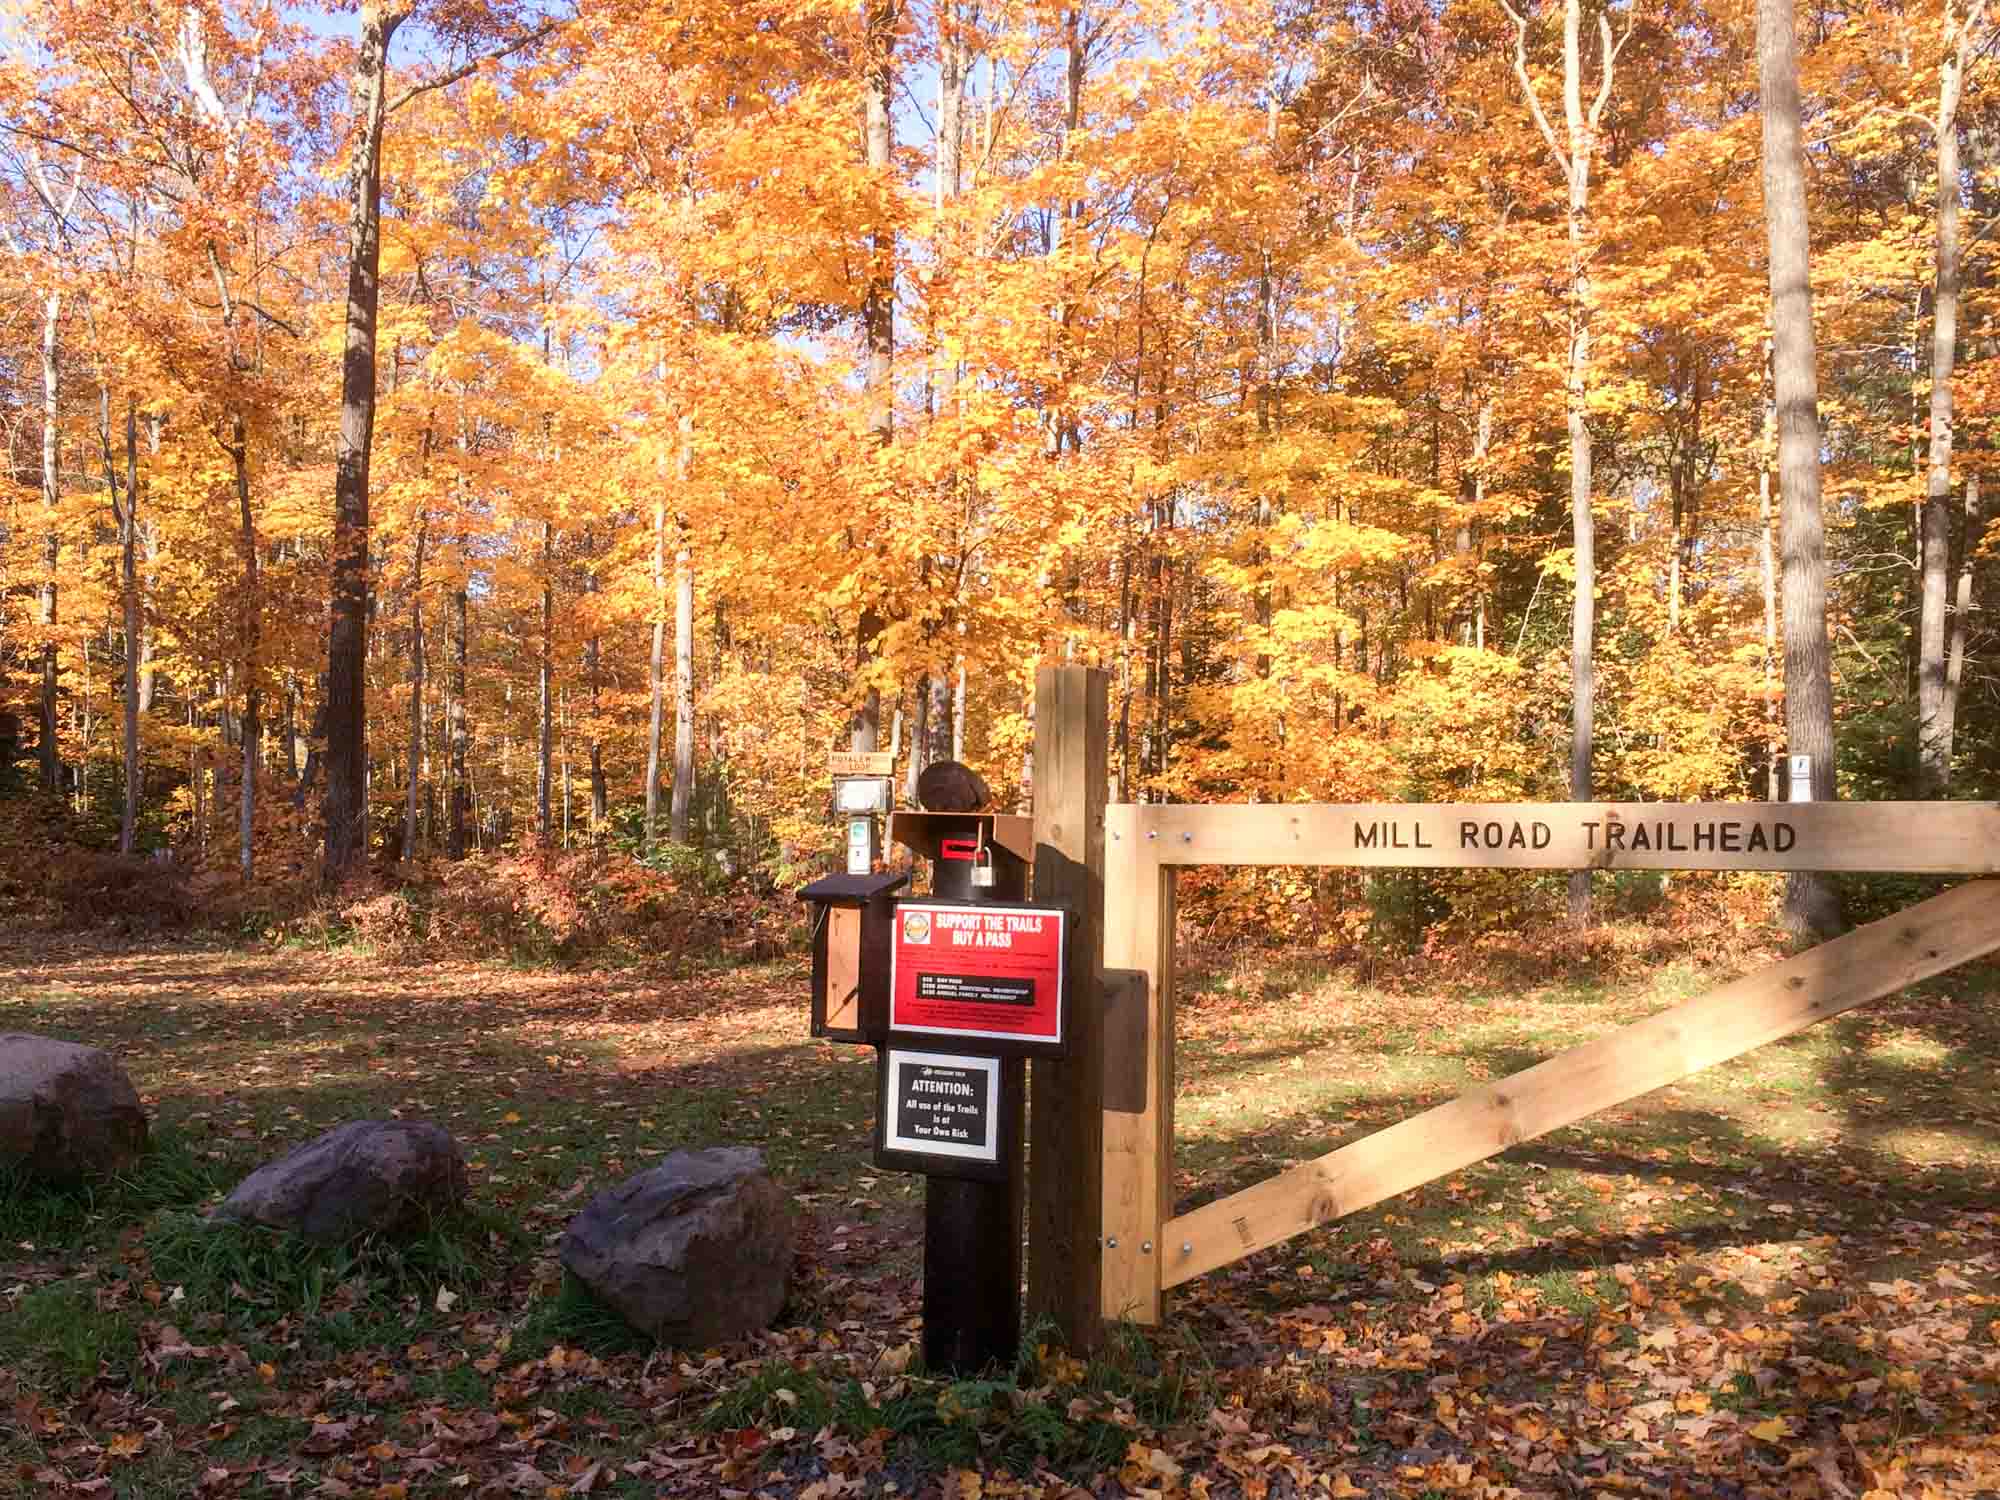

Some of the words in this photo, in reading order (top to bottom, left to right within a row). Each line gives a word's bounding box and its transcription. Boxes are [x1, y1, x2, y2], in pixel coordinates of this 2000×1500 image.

[1354, 822, 1432, 849] MILL
[1461, 821, 1551, 849] ROAD
[1581, 822, 1796, 852] TRAILHEAD
[936, 913, 982, 929] SUPPORT
[983, 915, 1004, 930] THE
[1006, 916, 1042, 933] TRAILS
[952, 931, 973, 945] BUY
[975, 931, 984, 946] A
[985, 932, 1011, 947] PASS
[912, 1080, 974, 1097] ATTENTION:
[906, 1099, 917, 1109] All
[933, 1102, 942, 1110] of
[943, 1103, 955, 1112] the
[957, 1104, 978, 1114] Trails
[942, 1116, 950, 1124] at
[914, 1125, 931, 1134] Your
[933, 1127, 950, 1136] Own
[952, 1128, 968, 1138] Risk
